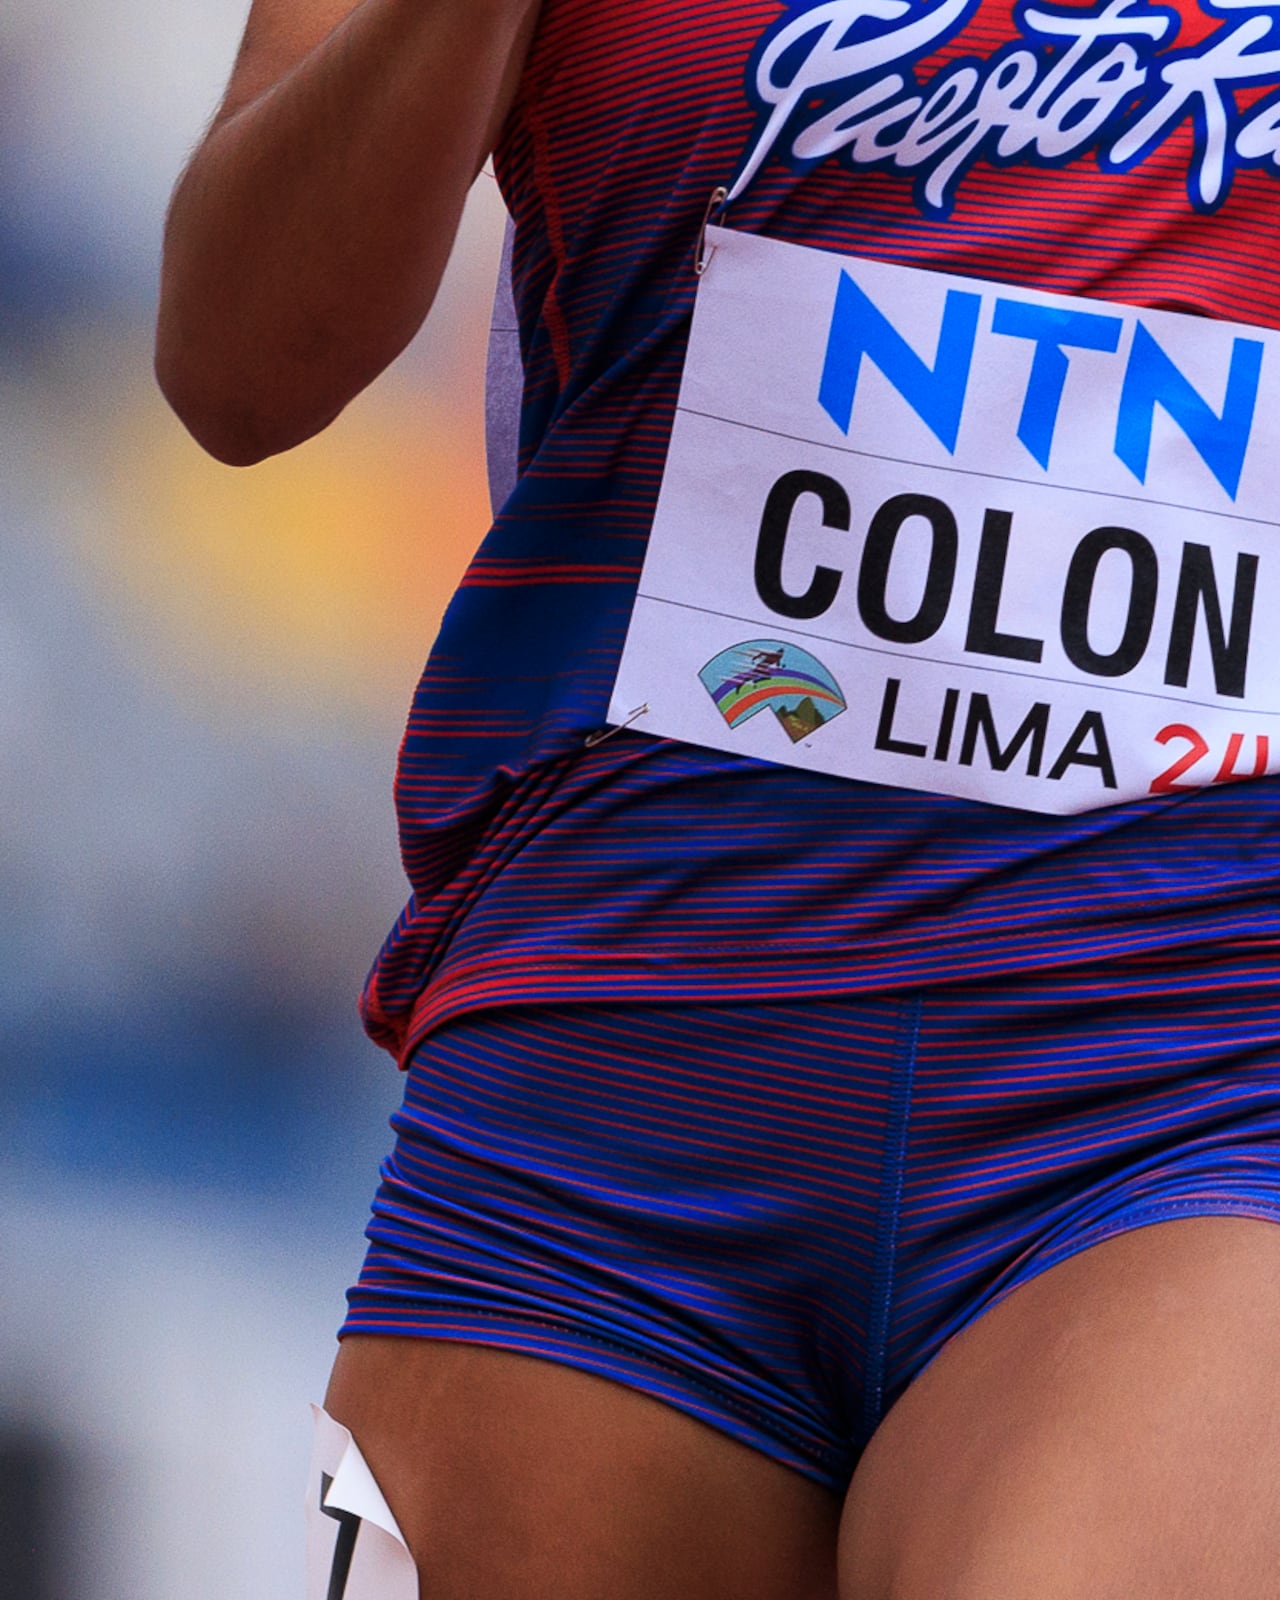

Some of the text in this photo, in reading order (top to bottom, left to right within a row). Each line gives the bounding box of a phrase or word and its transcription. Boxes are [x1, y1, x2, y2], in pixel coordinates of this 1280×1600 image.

[818, 268, 1265, 502] NTN
[754, 469, 1259, 698] COLON
[873, 678, 1268, 793] LIMA 24
